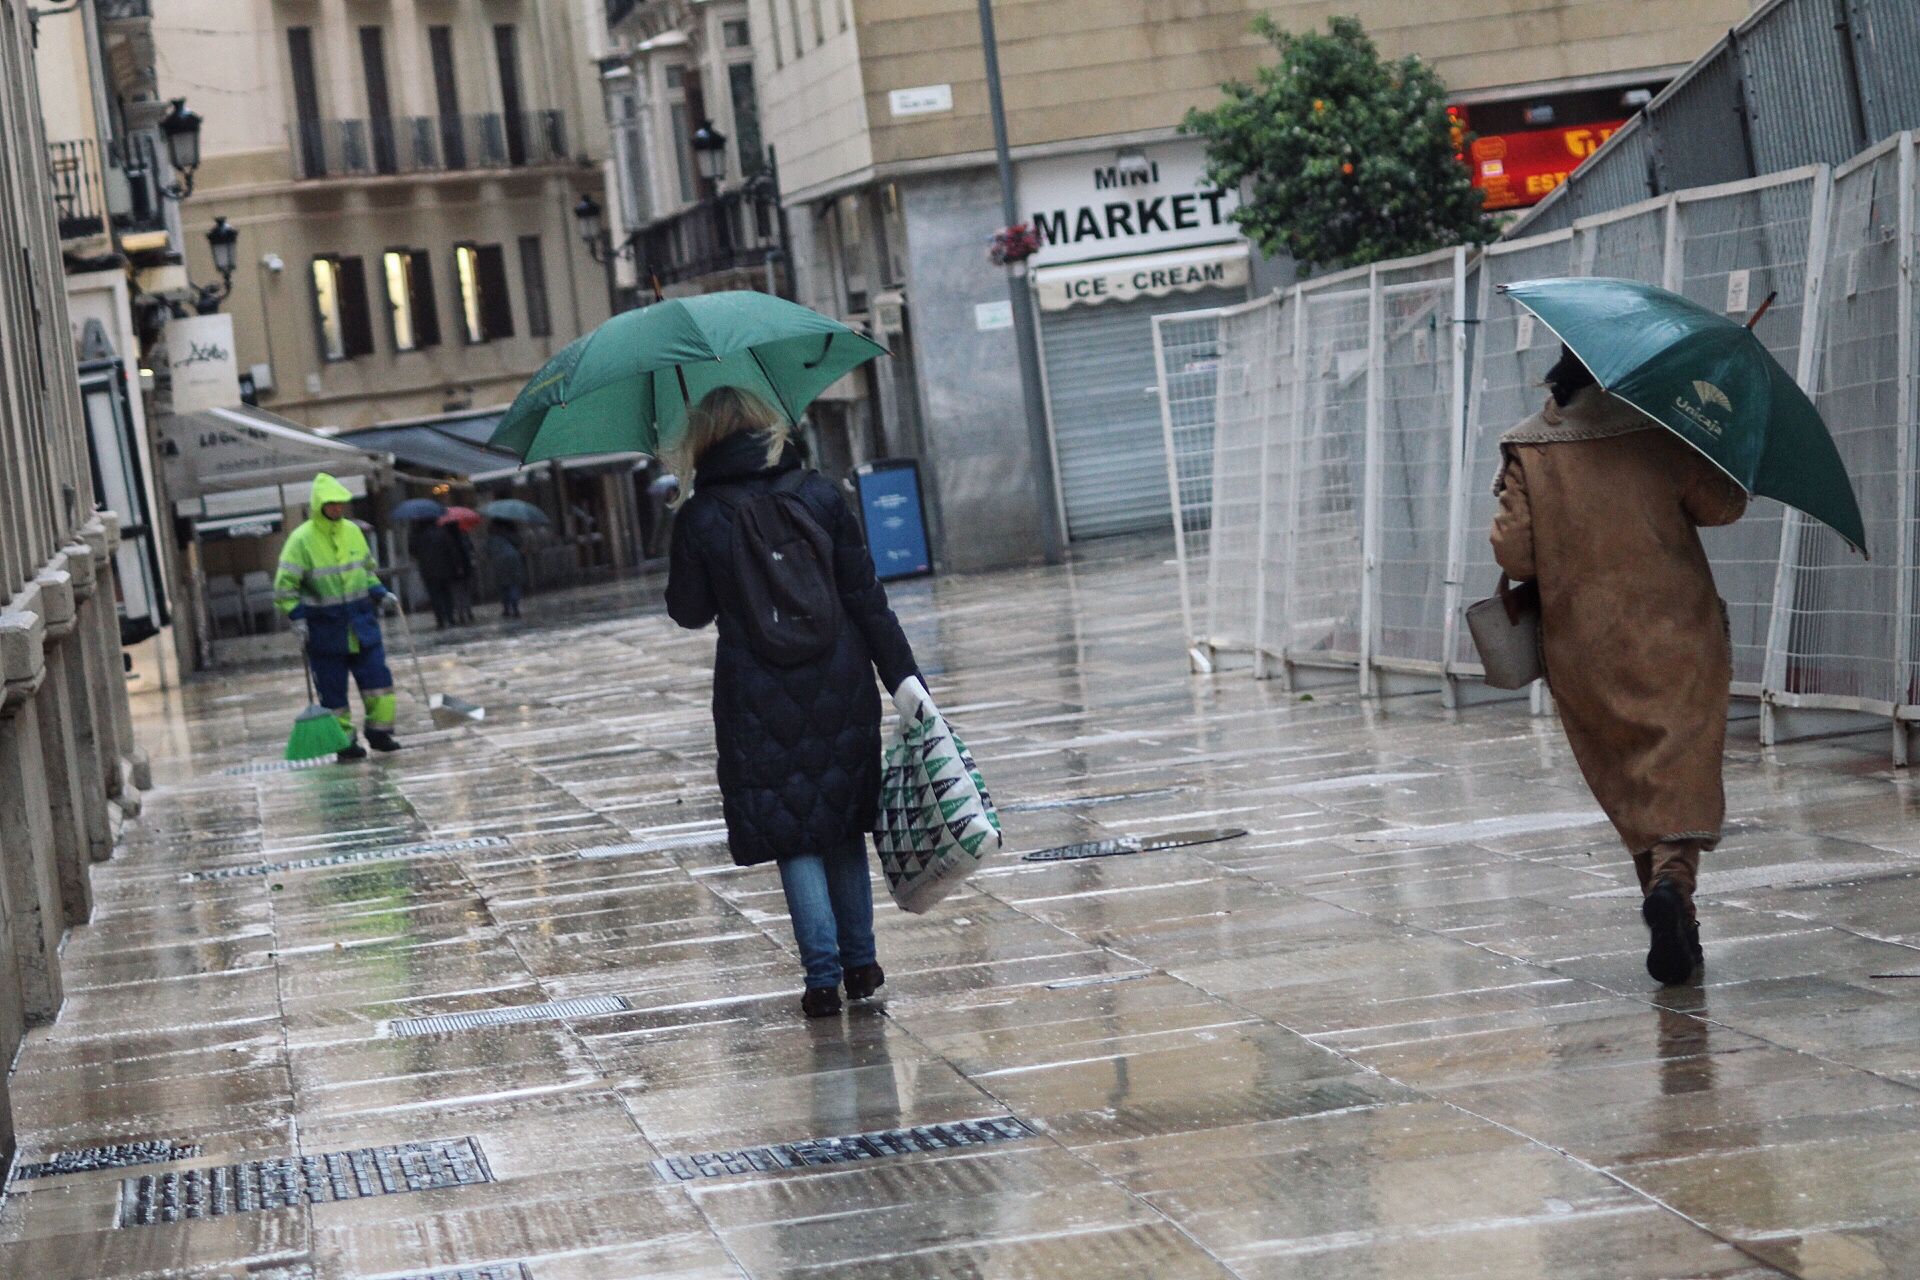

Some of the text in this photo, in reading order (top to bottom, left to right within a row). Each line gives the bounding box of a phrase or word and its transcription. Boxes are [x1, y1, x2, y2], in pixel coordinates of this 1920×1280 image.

[1032, 186, 1228, 247] MARKET
[1064, 276, 1108, 300] ICE
[1132, 262, 1226, 291] CREAM
[1675, 395, 1723, 437] Unicaja
